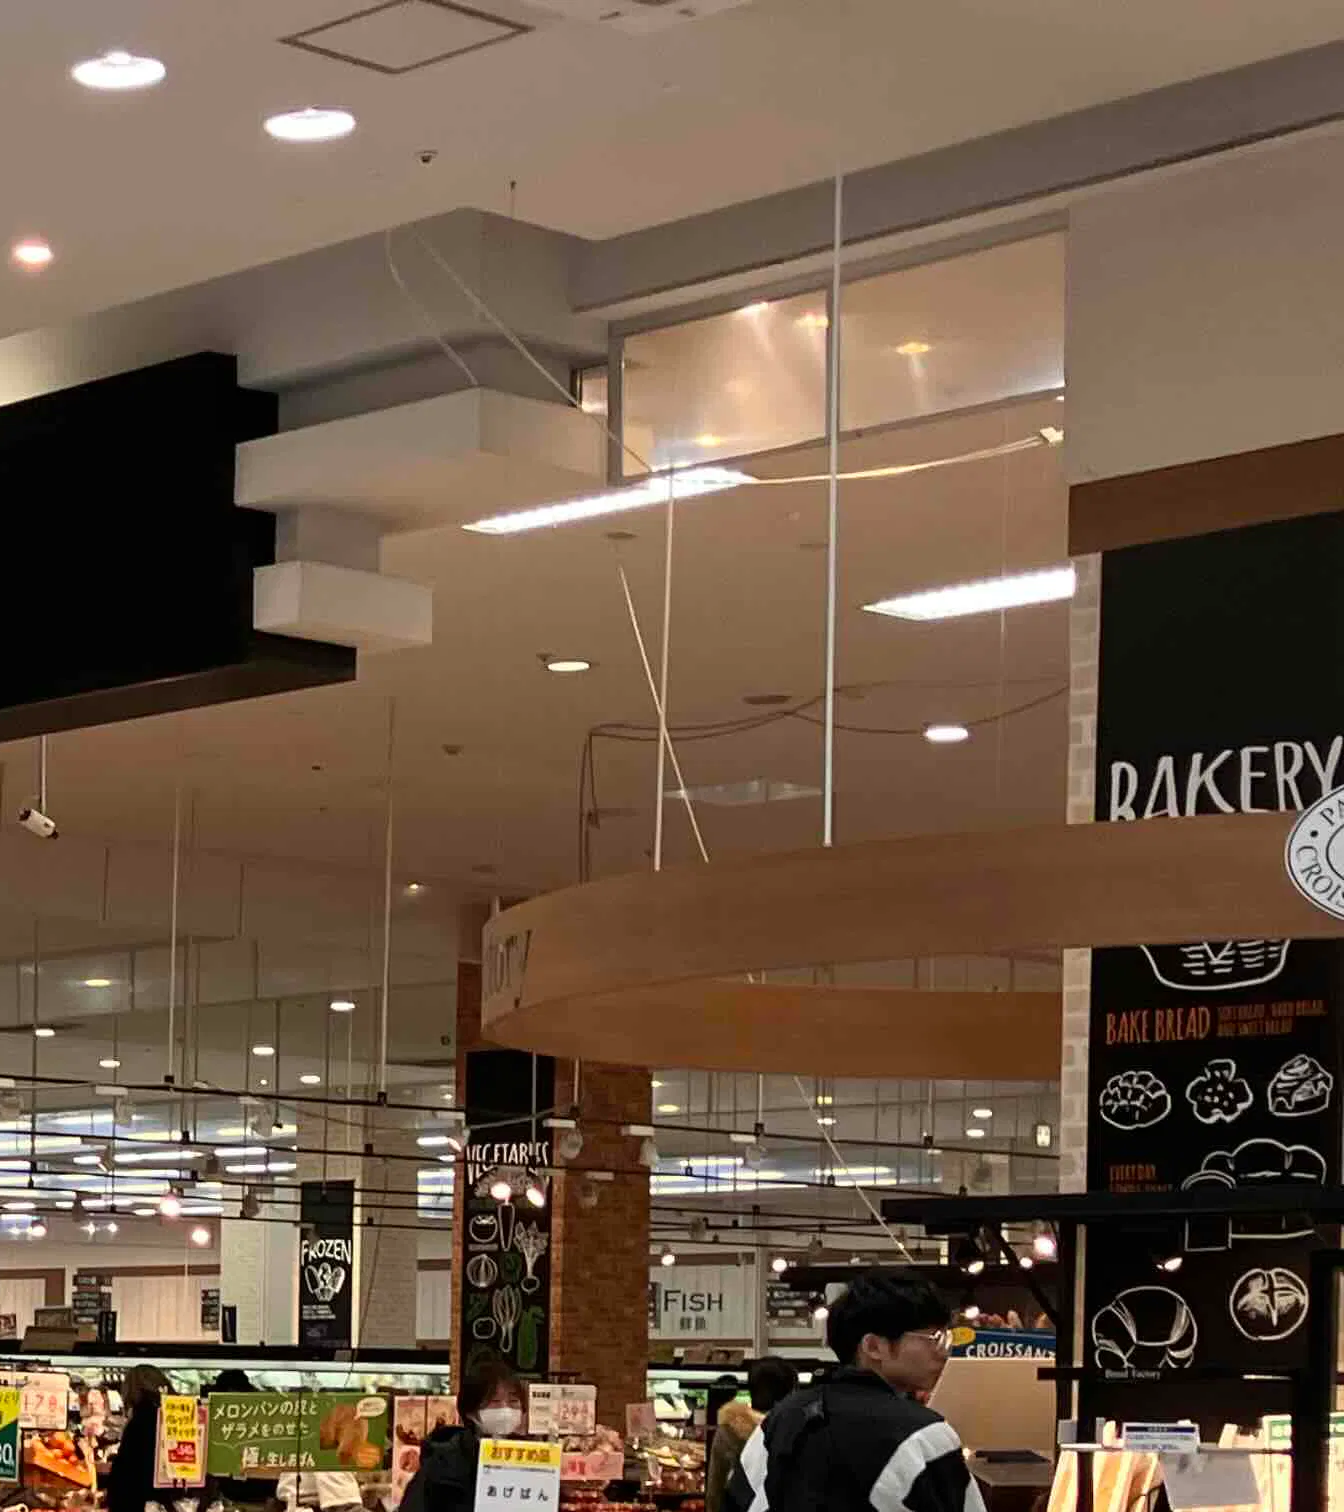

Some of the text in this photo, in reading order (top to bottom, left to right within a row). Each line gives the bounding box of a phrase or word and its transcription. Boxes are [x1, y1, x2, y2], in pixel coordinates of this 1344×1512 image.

[1110, 735, 1343, 822] BAKERY
[1296, 845, 1344, 908] CROI
[1105, 1006, 1211, 1045] BAKE BREAD
[301, 1239, 352, 1266] FROZEN
[663, 1289, 724, 1312] FISH
